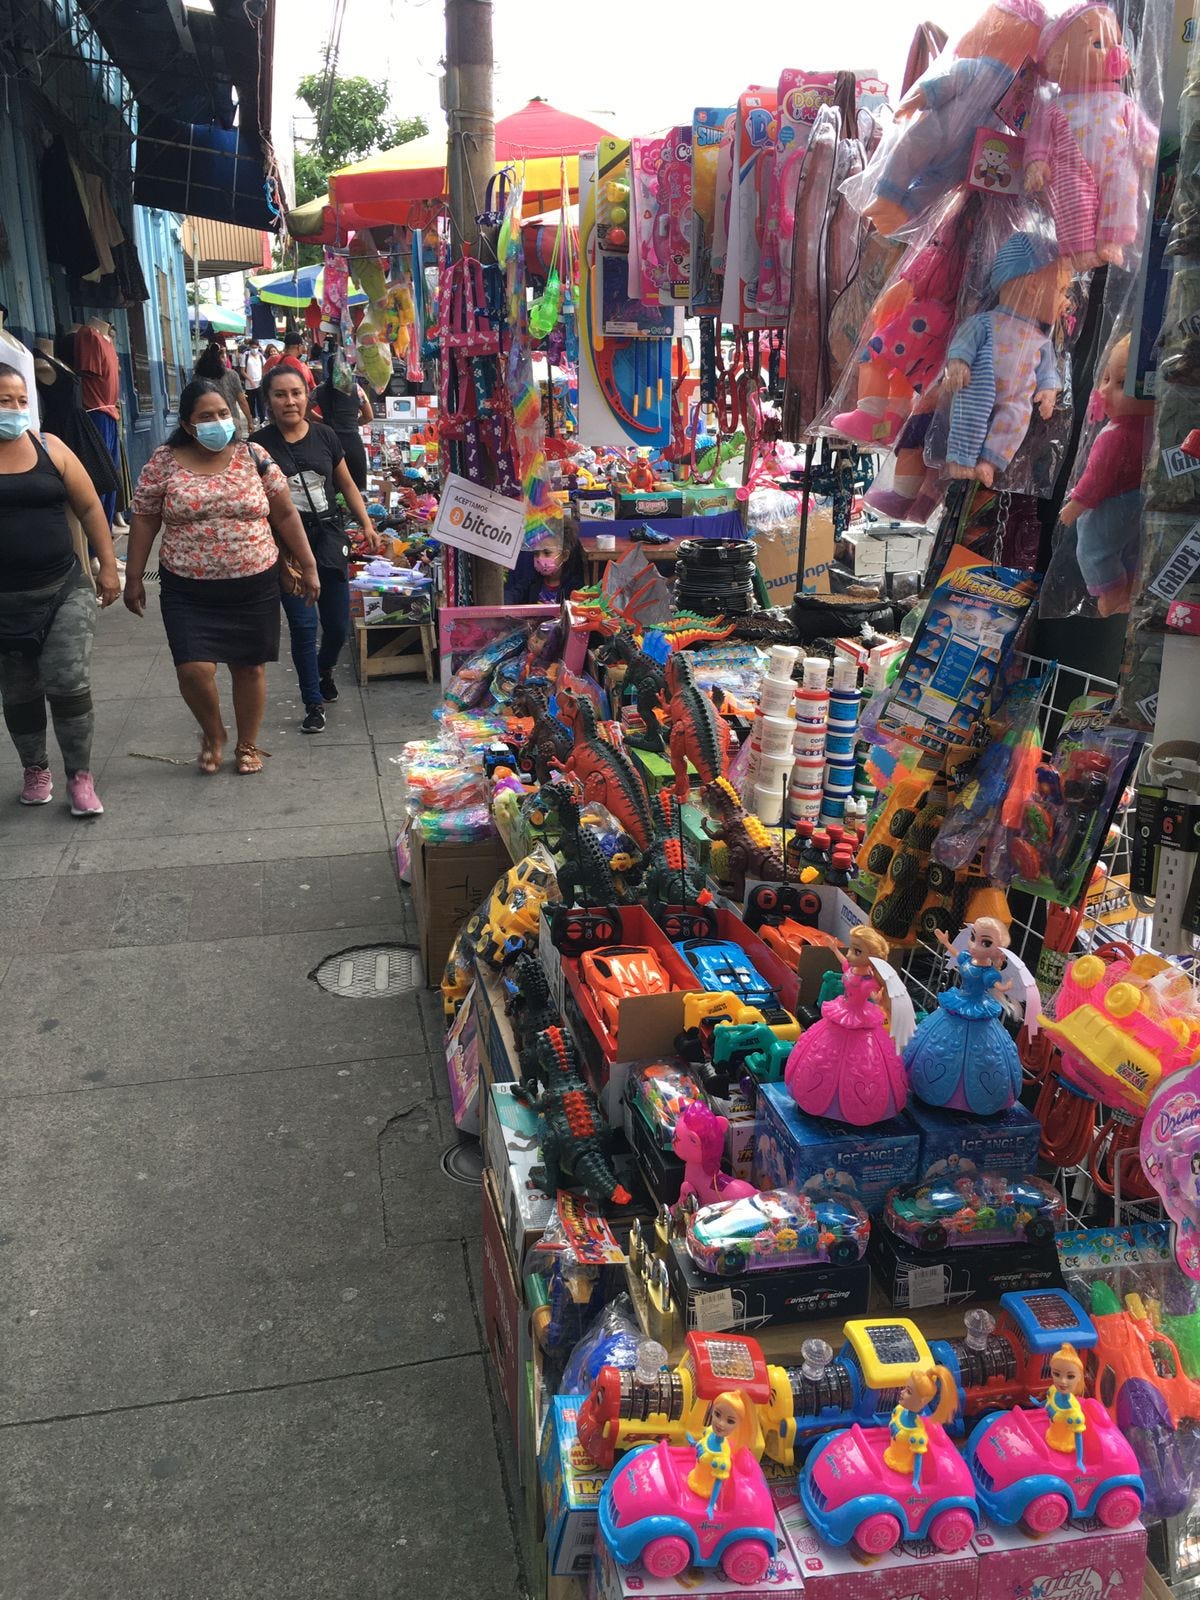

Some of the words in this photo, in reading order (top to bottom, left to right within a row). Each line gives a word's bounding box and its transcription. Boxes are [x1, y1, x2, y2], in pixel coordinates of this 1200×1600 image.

[454, 495, 489, 514] ACEPTAMOS
[461, 511, 512, 546] bitcoin
[1157, 545, 1200, 596] GRIPE
[962, 1138, 984, 1152] ICE
[837, 1151, 861, 1166] ICE
[784, 1293, 820, 1305] Concept
[821, 1289, 851, 1300] Racing
